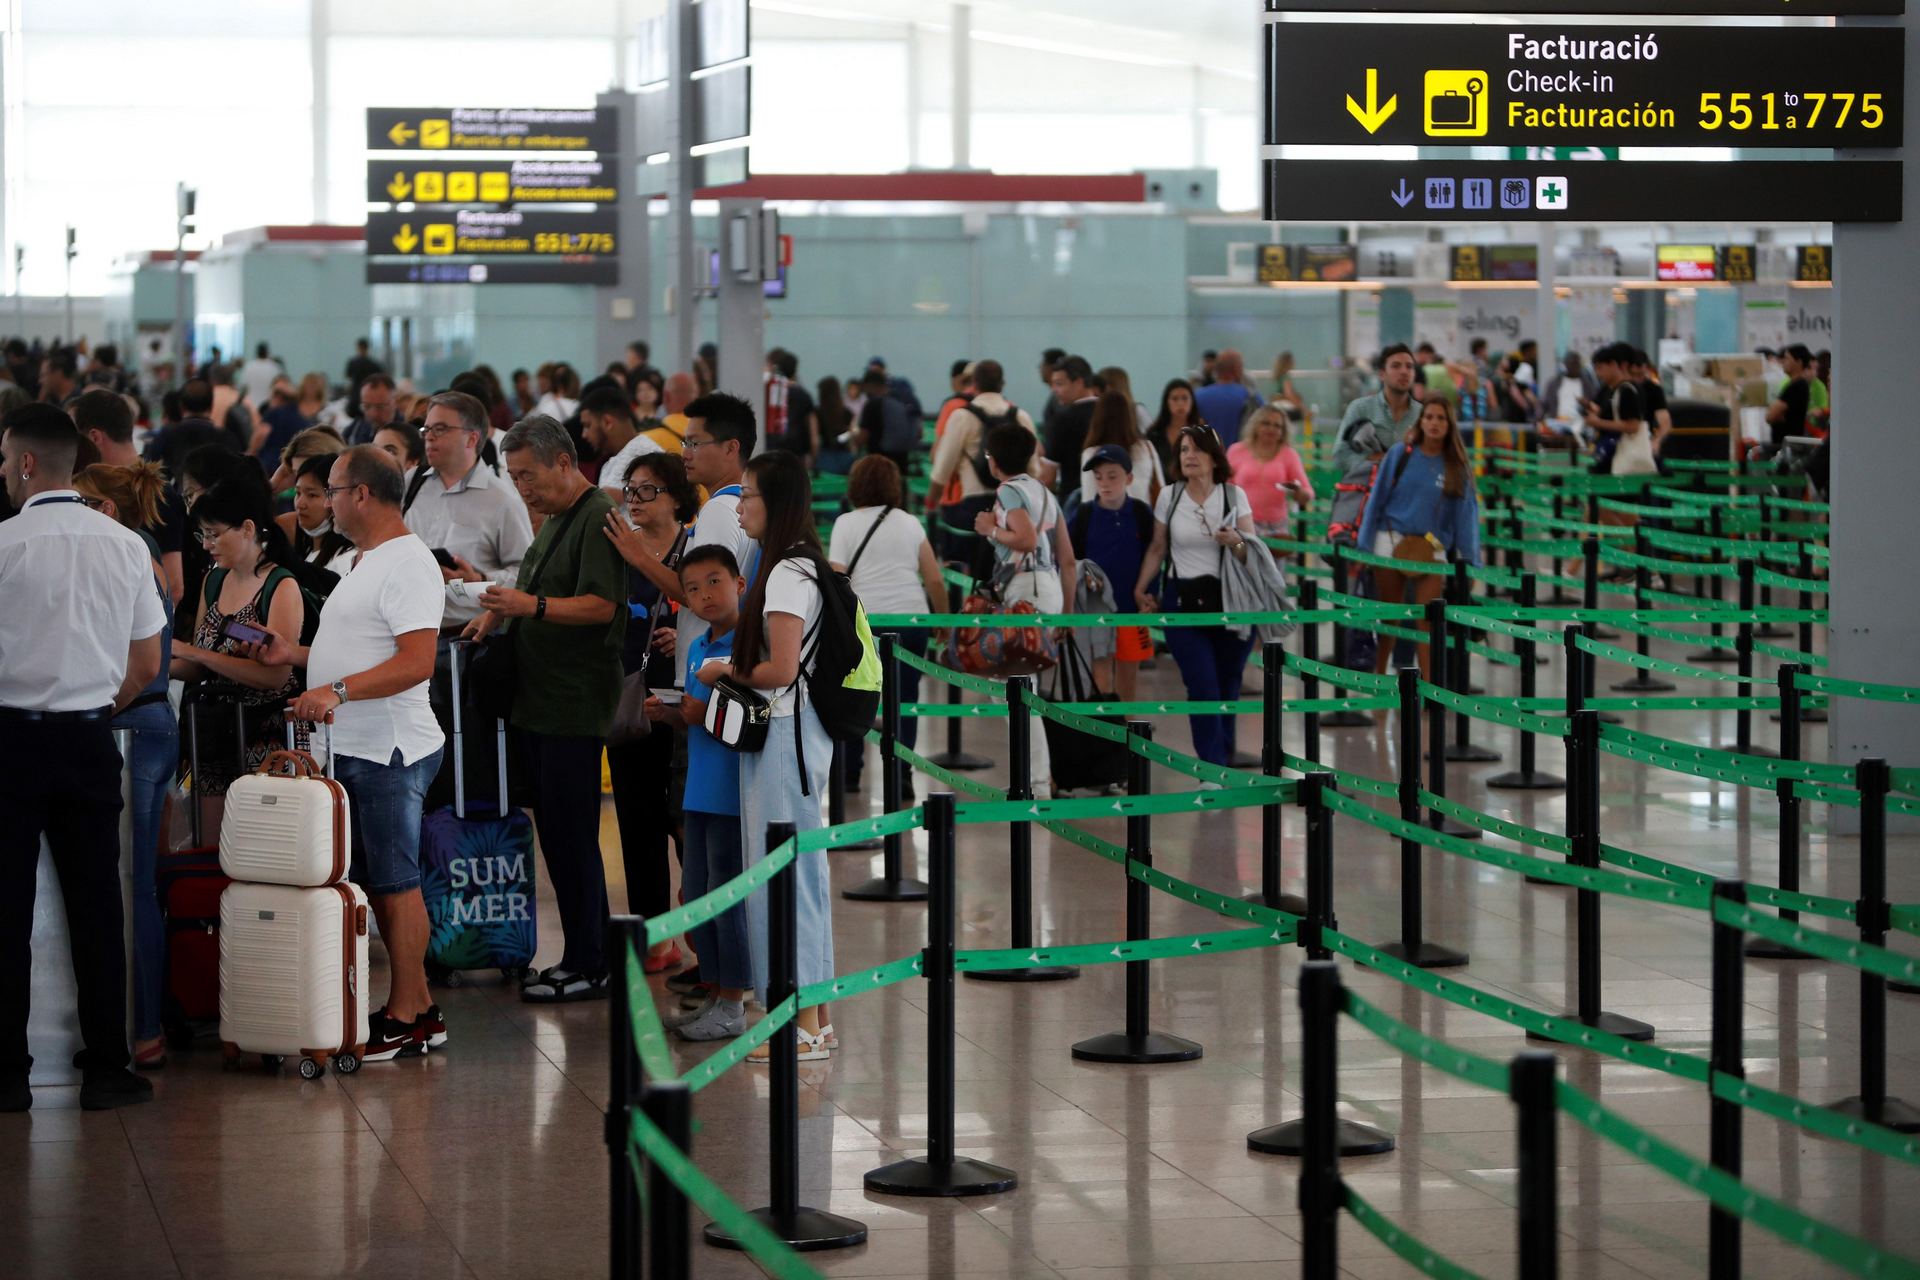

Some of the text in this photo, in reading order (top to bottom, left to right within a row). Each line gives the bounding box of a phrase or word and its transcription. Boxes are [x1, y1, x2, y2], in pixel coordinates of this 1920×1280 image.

[1507, 33, 1659, 61] Facturació
[1507, 69, 1614, 93] Check-in
[1507, 92, 1884, 130] Facturación 551 a 775
[1784, 91, 1799, 107] to
[577, 232, 614, 253] 775
[449, 853, 528, 888] SUM
[451, 893, 531, 926] MER
